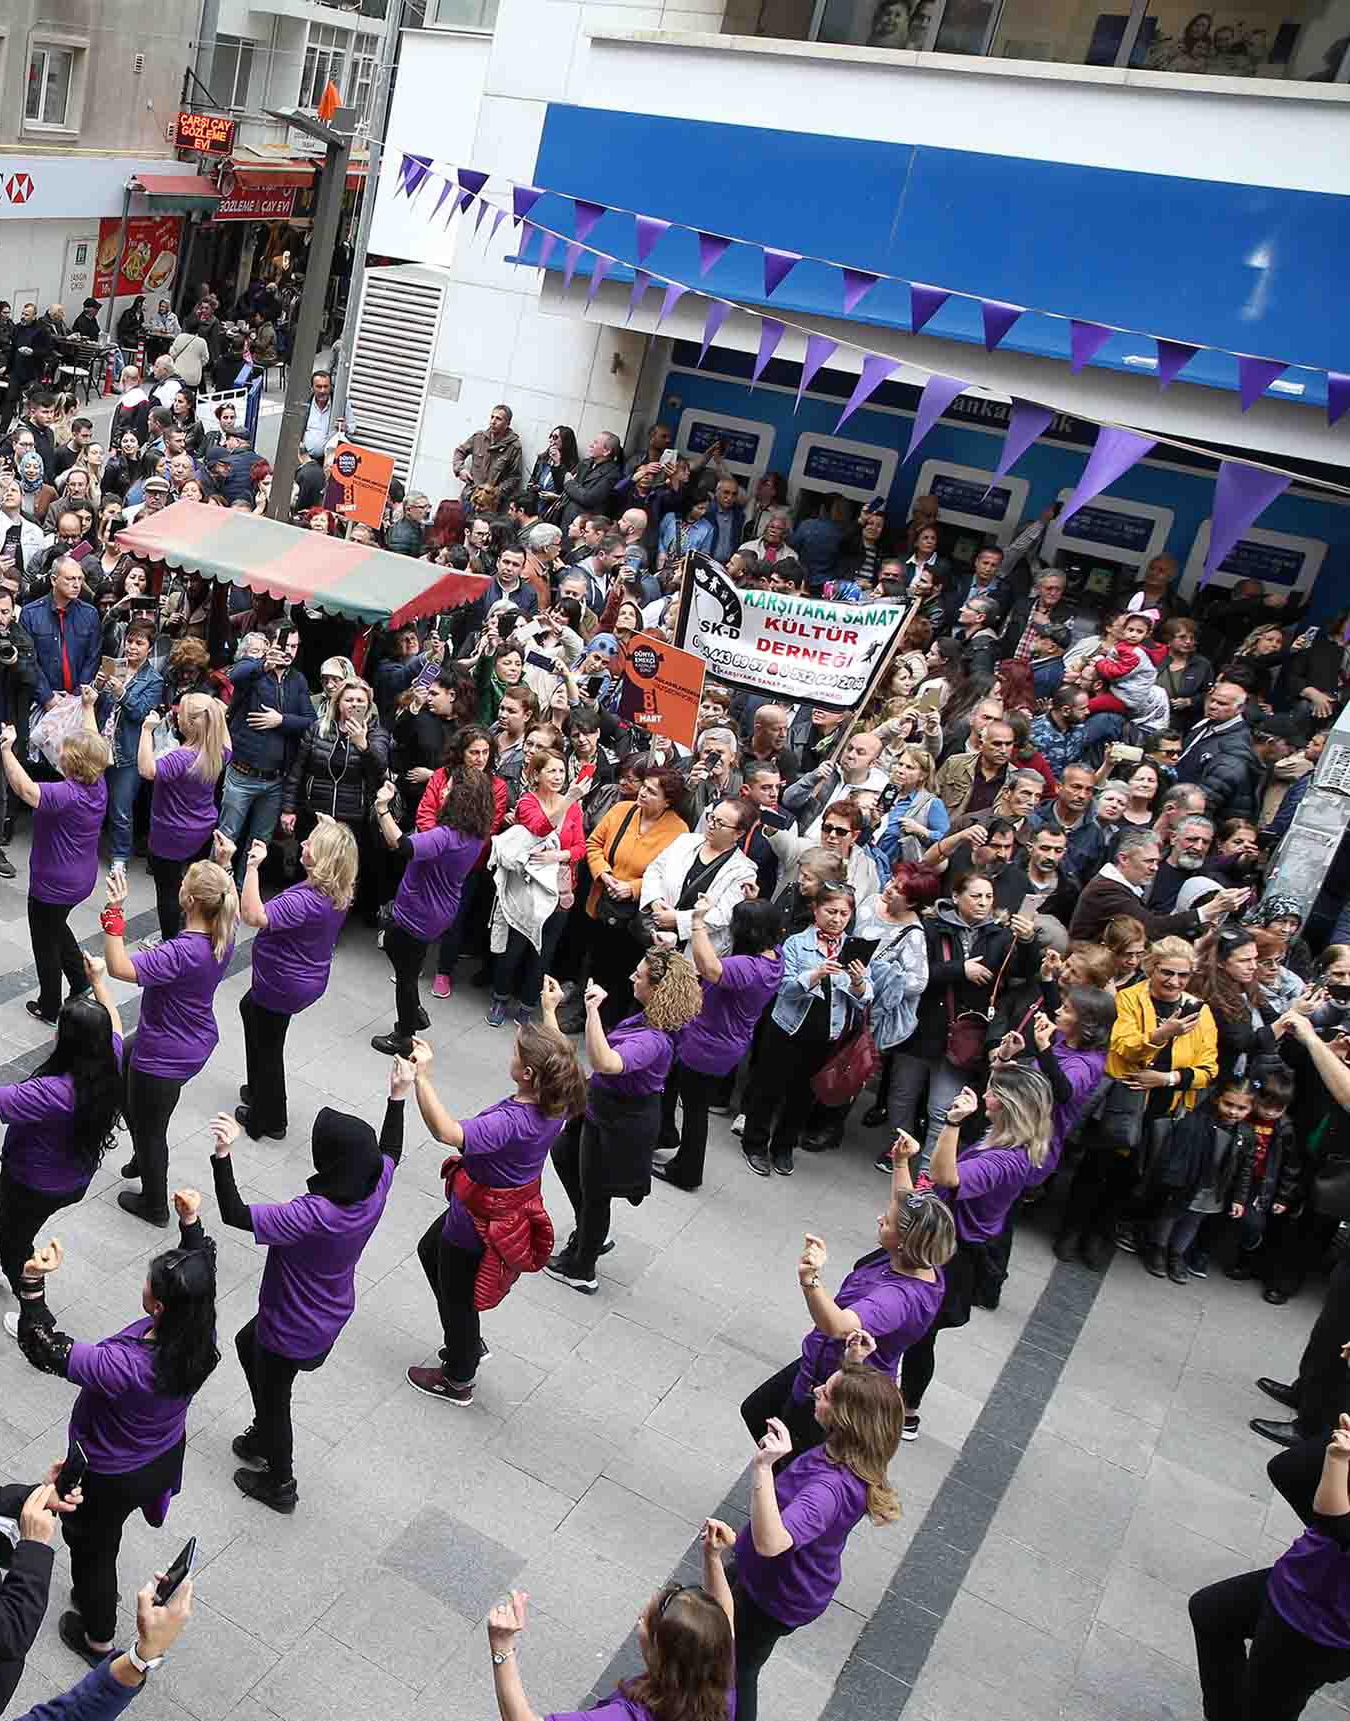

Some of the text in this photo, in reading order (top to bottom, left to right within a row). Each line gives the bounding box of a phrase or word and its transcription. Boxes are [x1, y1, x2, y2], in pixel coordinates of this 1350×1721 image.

[744, 591, 898, 626] KARŞIYAKA SANAT
[764, 616, 858, 645] KÜLTÜR
[634, 650, 655, 658] DÜNYA
[634, 656, 656, 664] EMEKÇİ
[755, 637, 855, 668] DERNEĞİ
[644, 693, 654, 710] 8
[639, 714, 662, 723] MART
